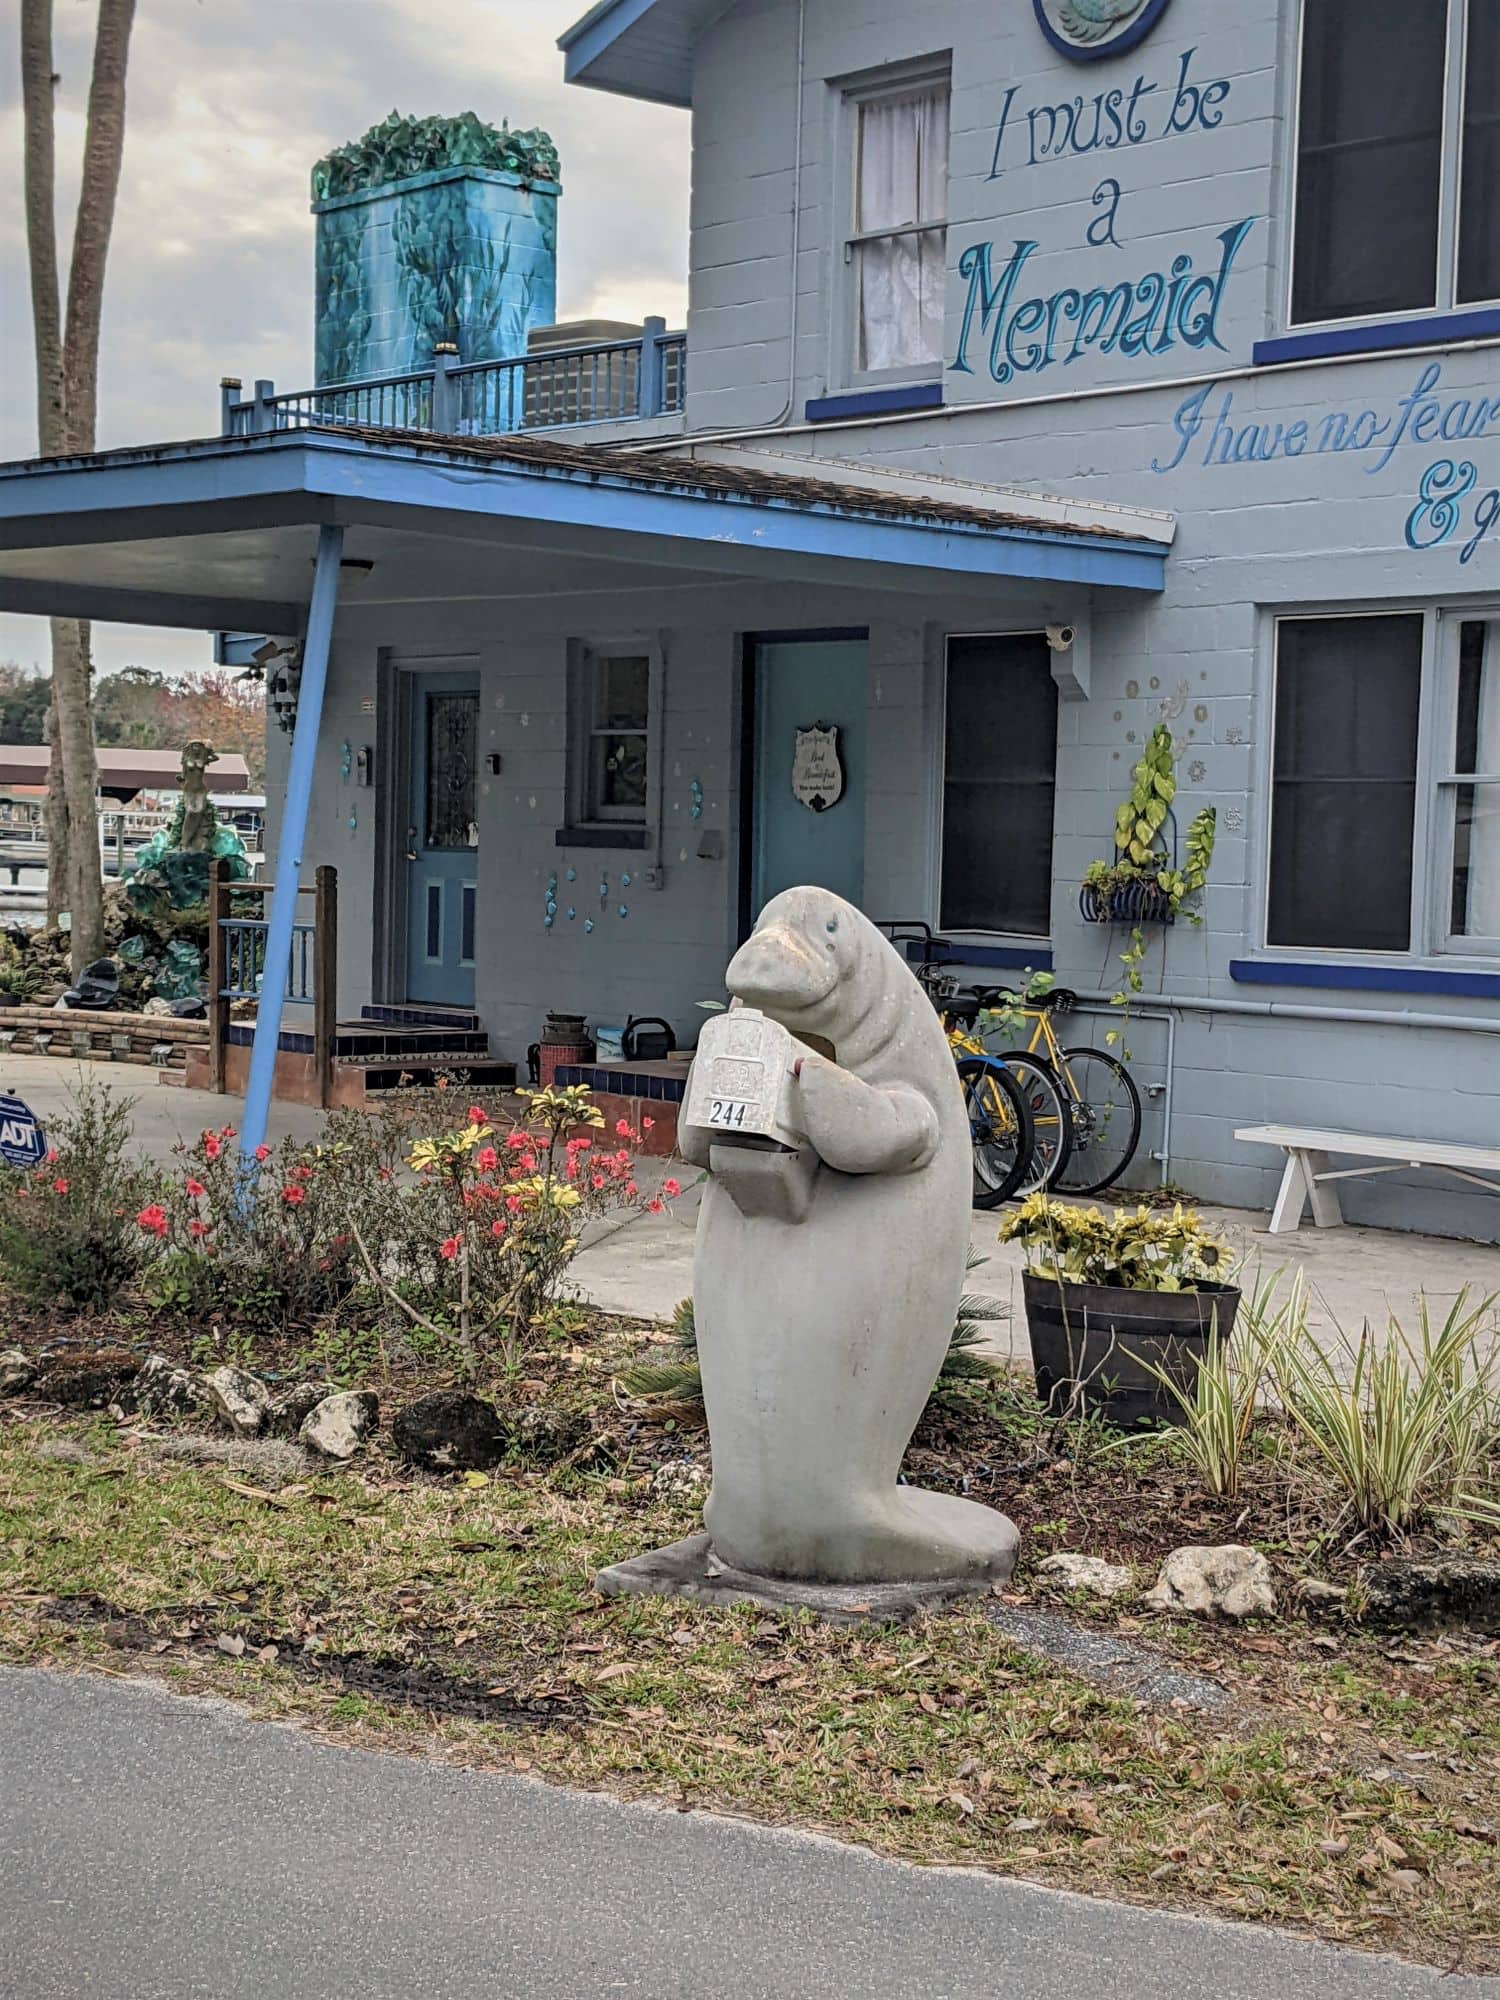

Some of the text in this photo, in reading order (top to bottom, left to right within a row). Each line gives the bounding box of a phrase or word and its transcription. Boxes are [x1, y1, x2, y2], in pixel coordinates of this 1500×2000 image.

[984, 46, 1231, 183] I must be
[1086, 178, 1125, 249] a
[946, 215, 1256, 384] Mermaid
[1151, 382, 1217, 473] I
[1202, 391, 1308, 467] have
[1318, 410, 1392, 452] no
[1405, 458, 1500, 565] & g
[1, 1119, 34, 1149] ADT
[710, 1101, 746, 1127] 244
